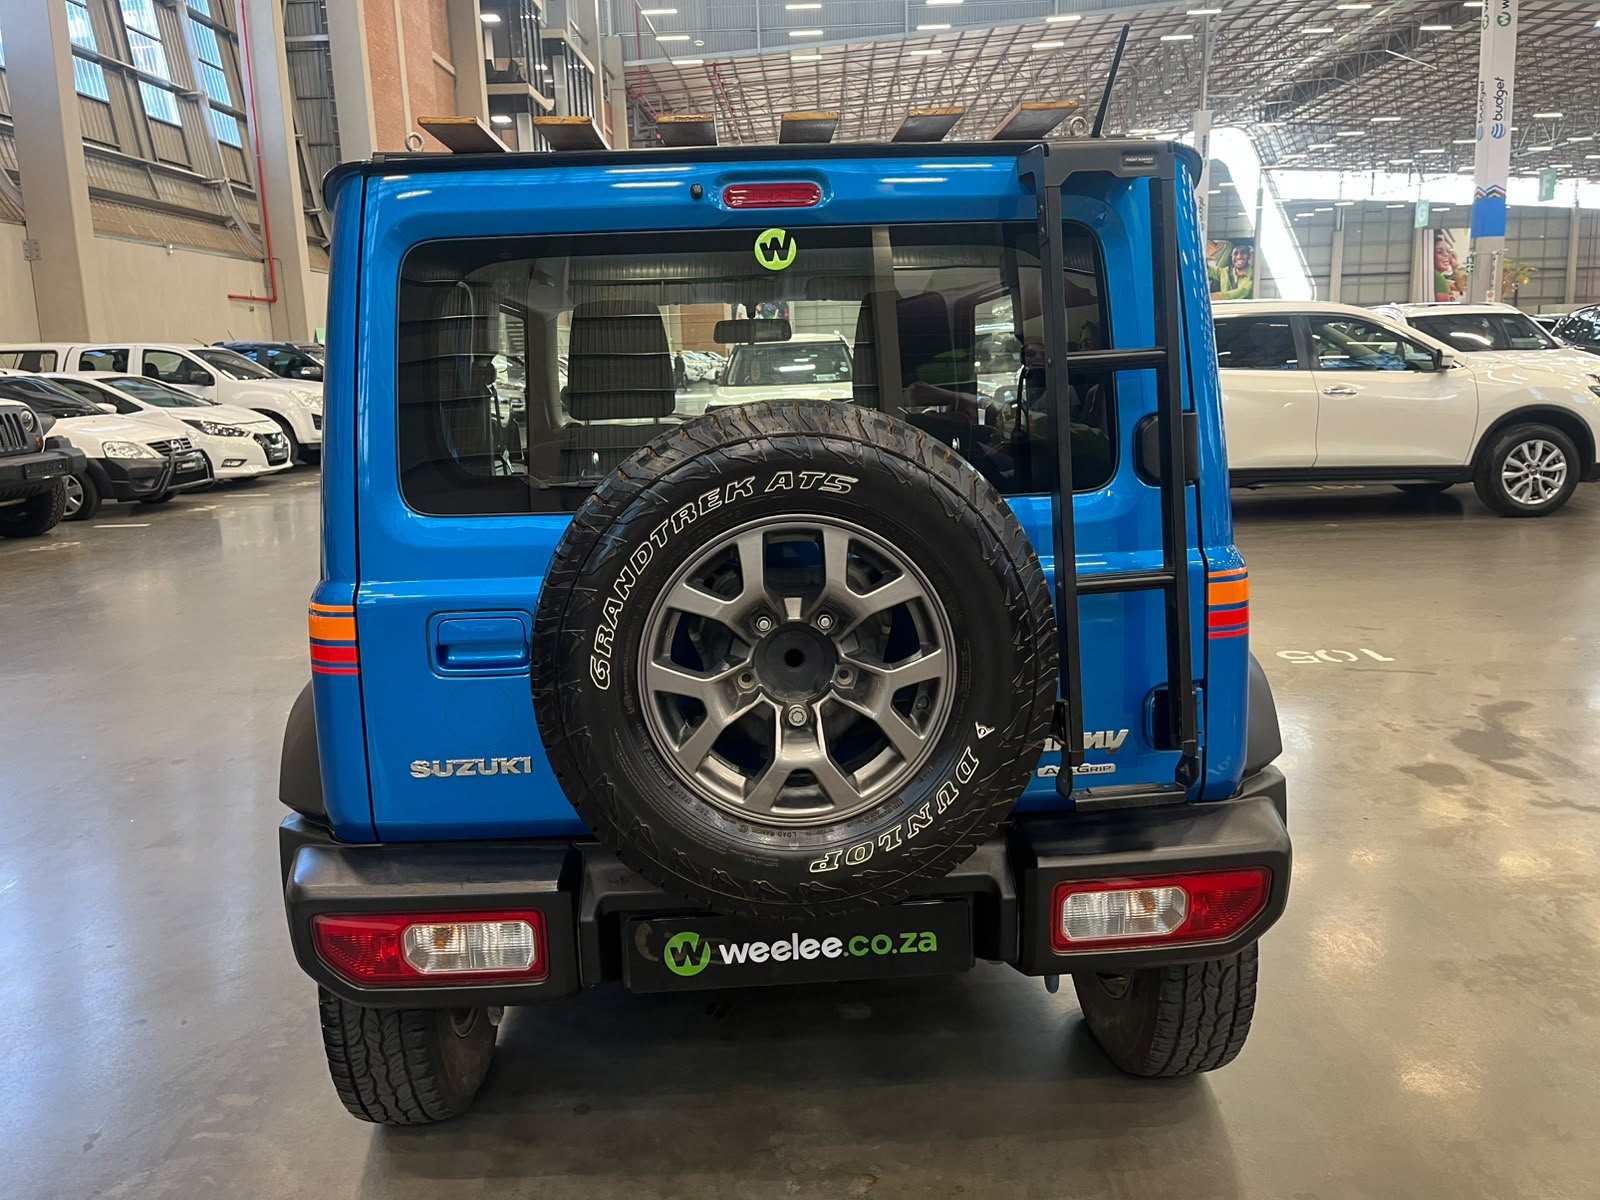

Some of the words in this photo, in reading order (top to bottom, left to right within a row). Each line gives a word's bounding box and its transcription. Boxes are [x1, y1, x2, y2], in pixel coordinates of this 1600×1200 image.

[1493, 76, 1508, 121] budget
[1417, 208, 1425, 221] G
[590, 476, 755, 690] GRANDTREK
[1276, 648, 1396, 664] 105
[410, 756, 532, 778] SUZUKI
[809, 746, 980, 873] DUNLOP
[719, 931, 938, 965] weelee.co.za
